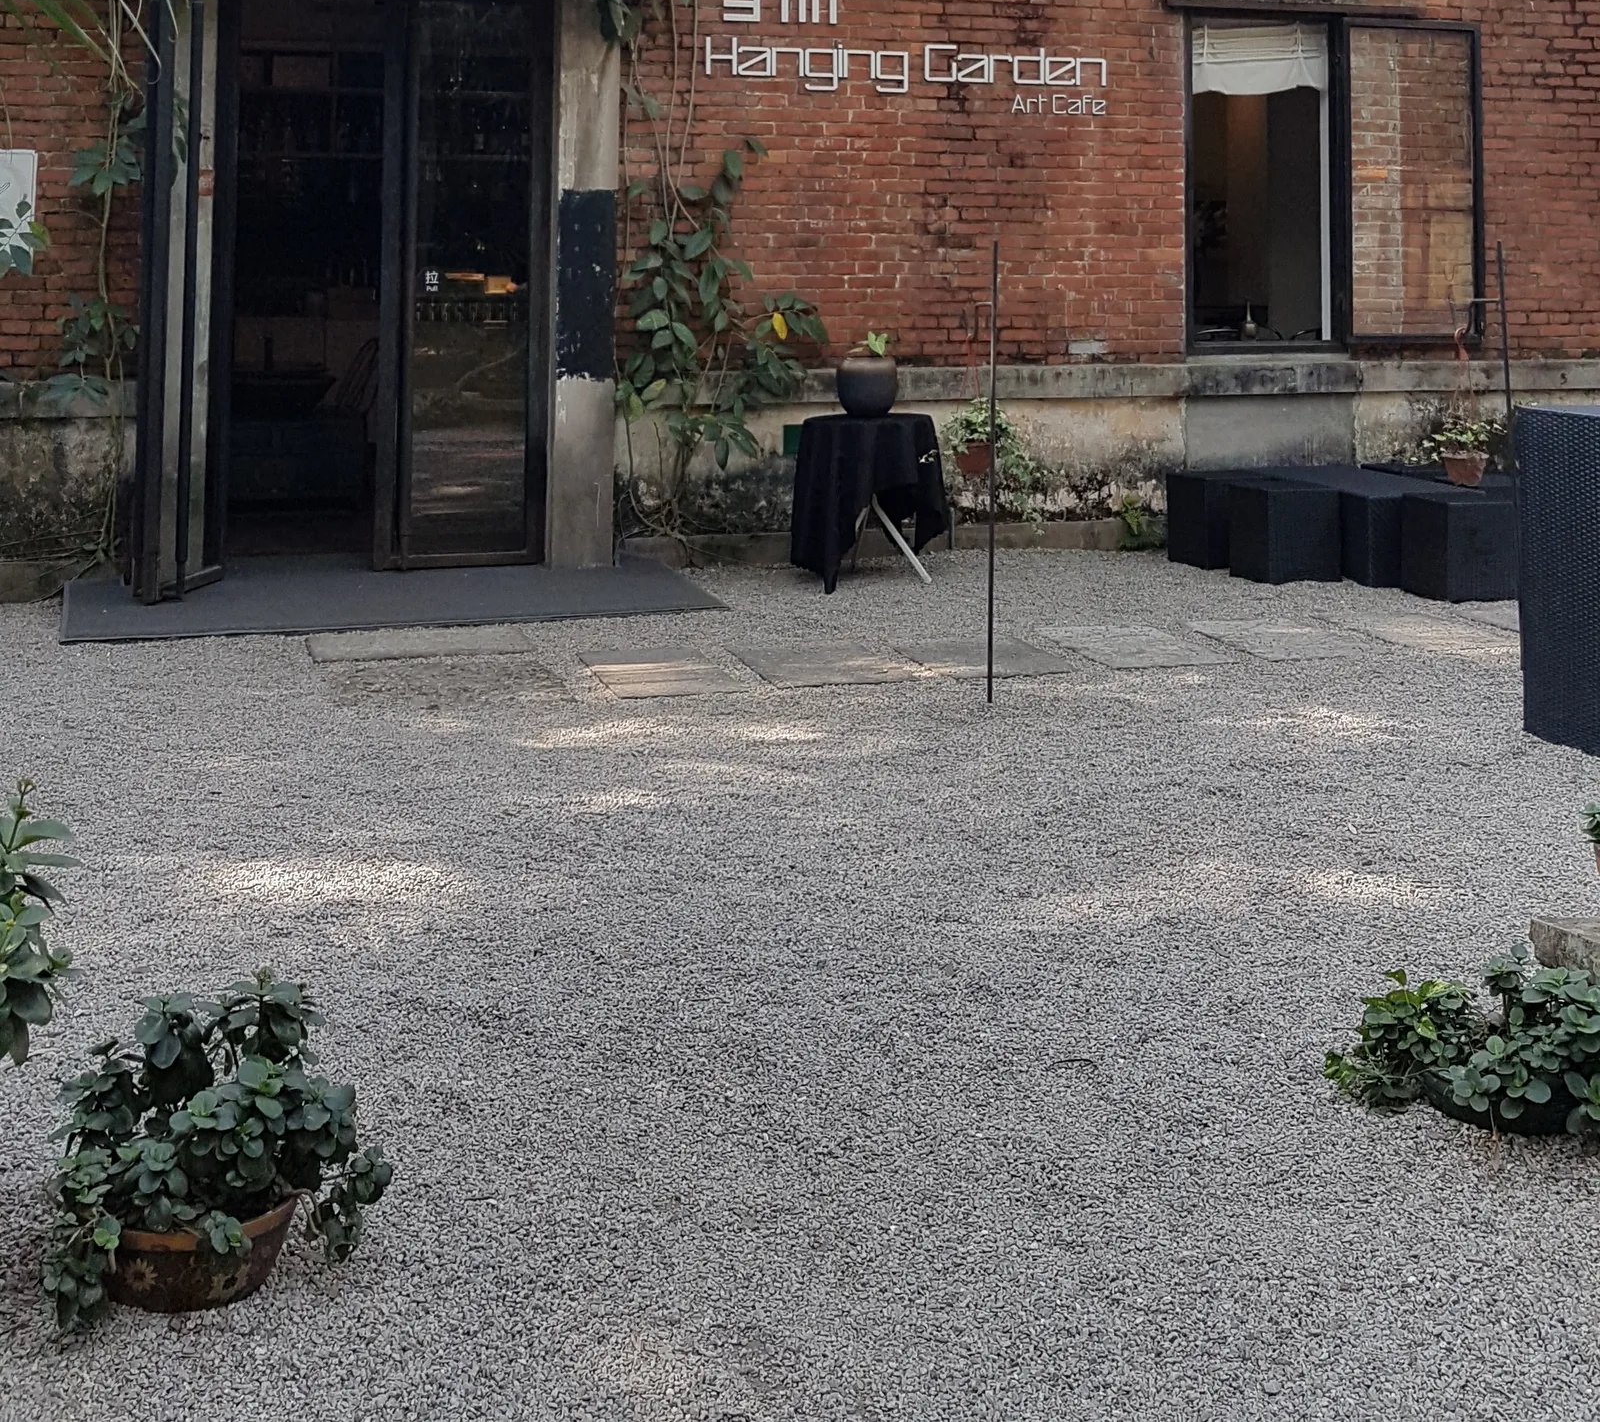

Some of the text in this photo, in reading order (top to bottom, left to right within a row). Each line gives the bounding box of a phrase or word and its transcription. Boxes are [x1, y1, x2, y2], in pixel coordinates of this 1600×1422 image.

[705, 36, 1107, 93] Hanging Garden
[1011, 93, 1106, 115] Art Cafe
[425, 270, 439, 284] 拉
